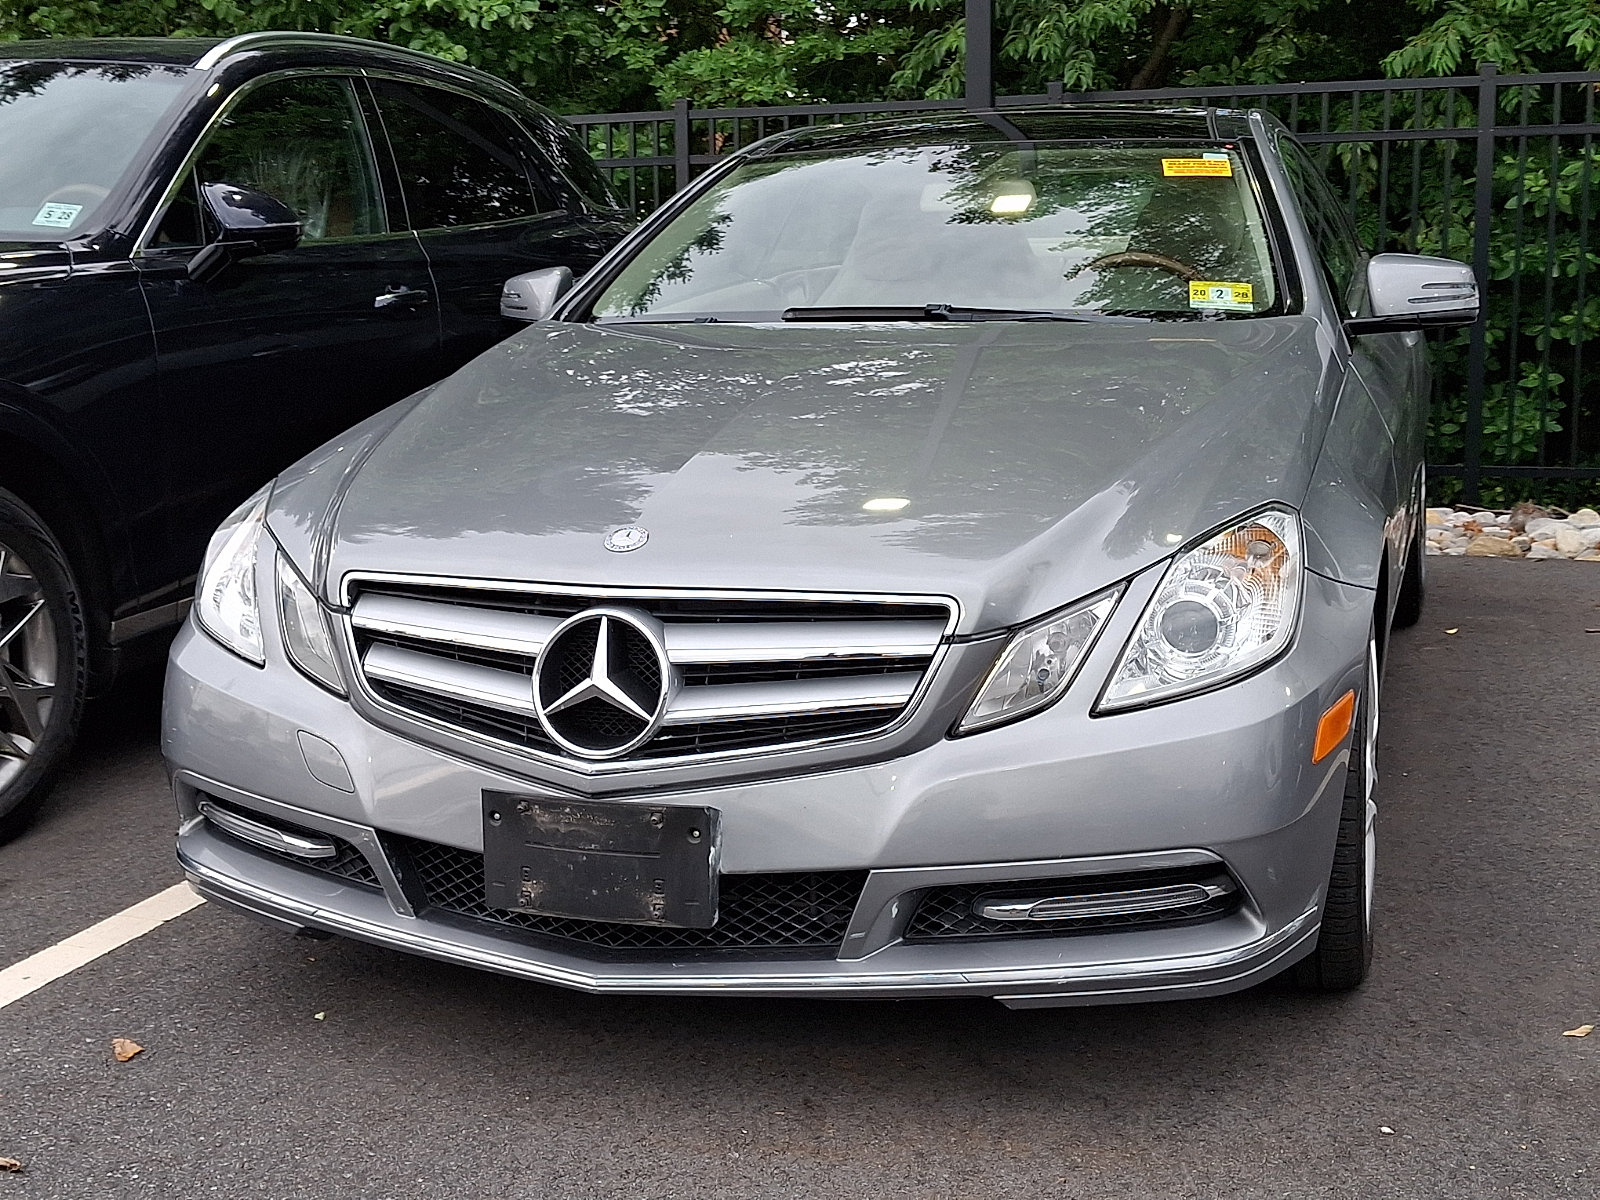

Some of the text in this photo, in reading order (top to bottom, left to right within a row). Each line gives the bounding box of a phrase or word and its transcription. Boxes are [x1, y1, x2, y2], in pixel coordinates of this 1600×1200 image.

[44, 210, 55, 219] 5
[1216, 289, 1224, 299] 2
[1234, 291, 1249, 299] 28
